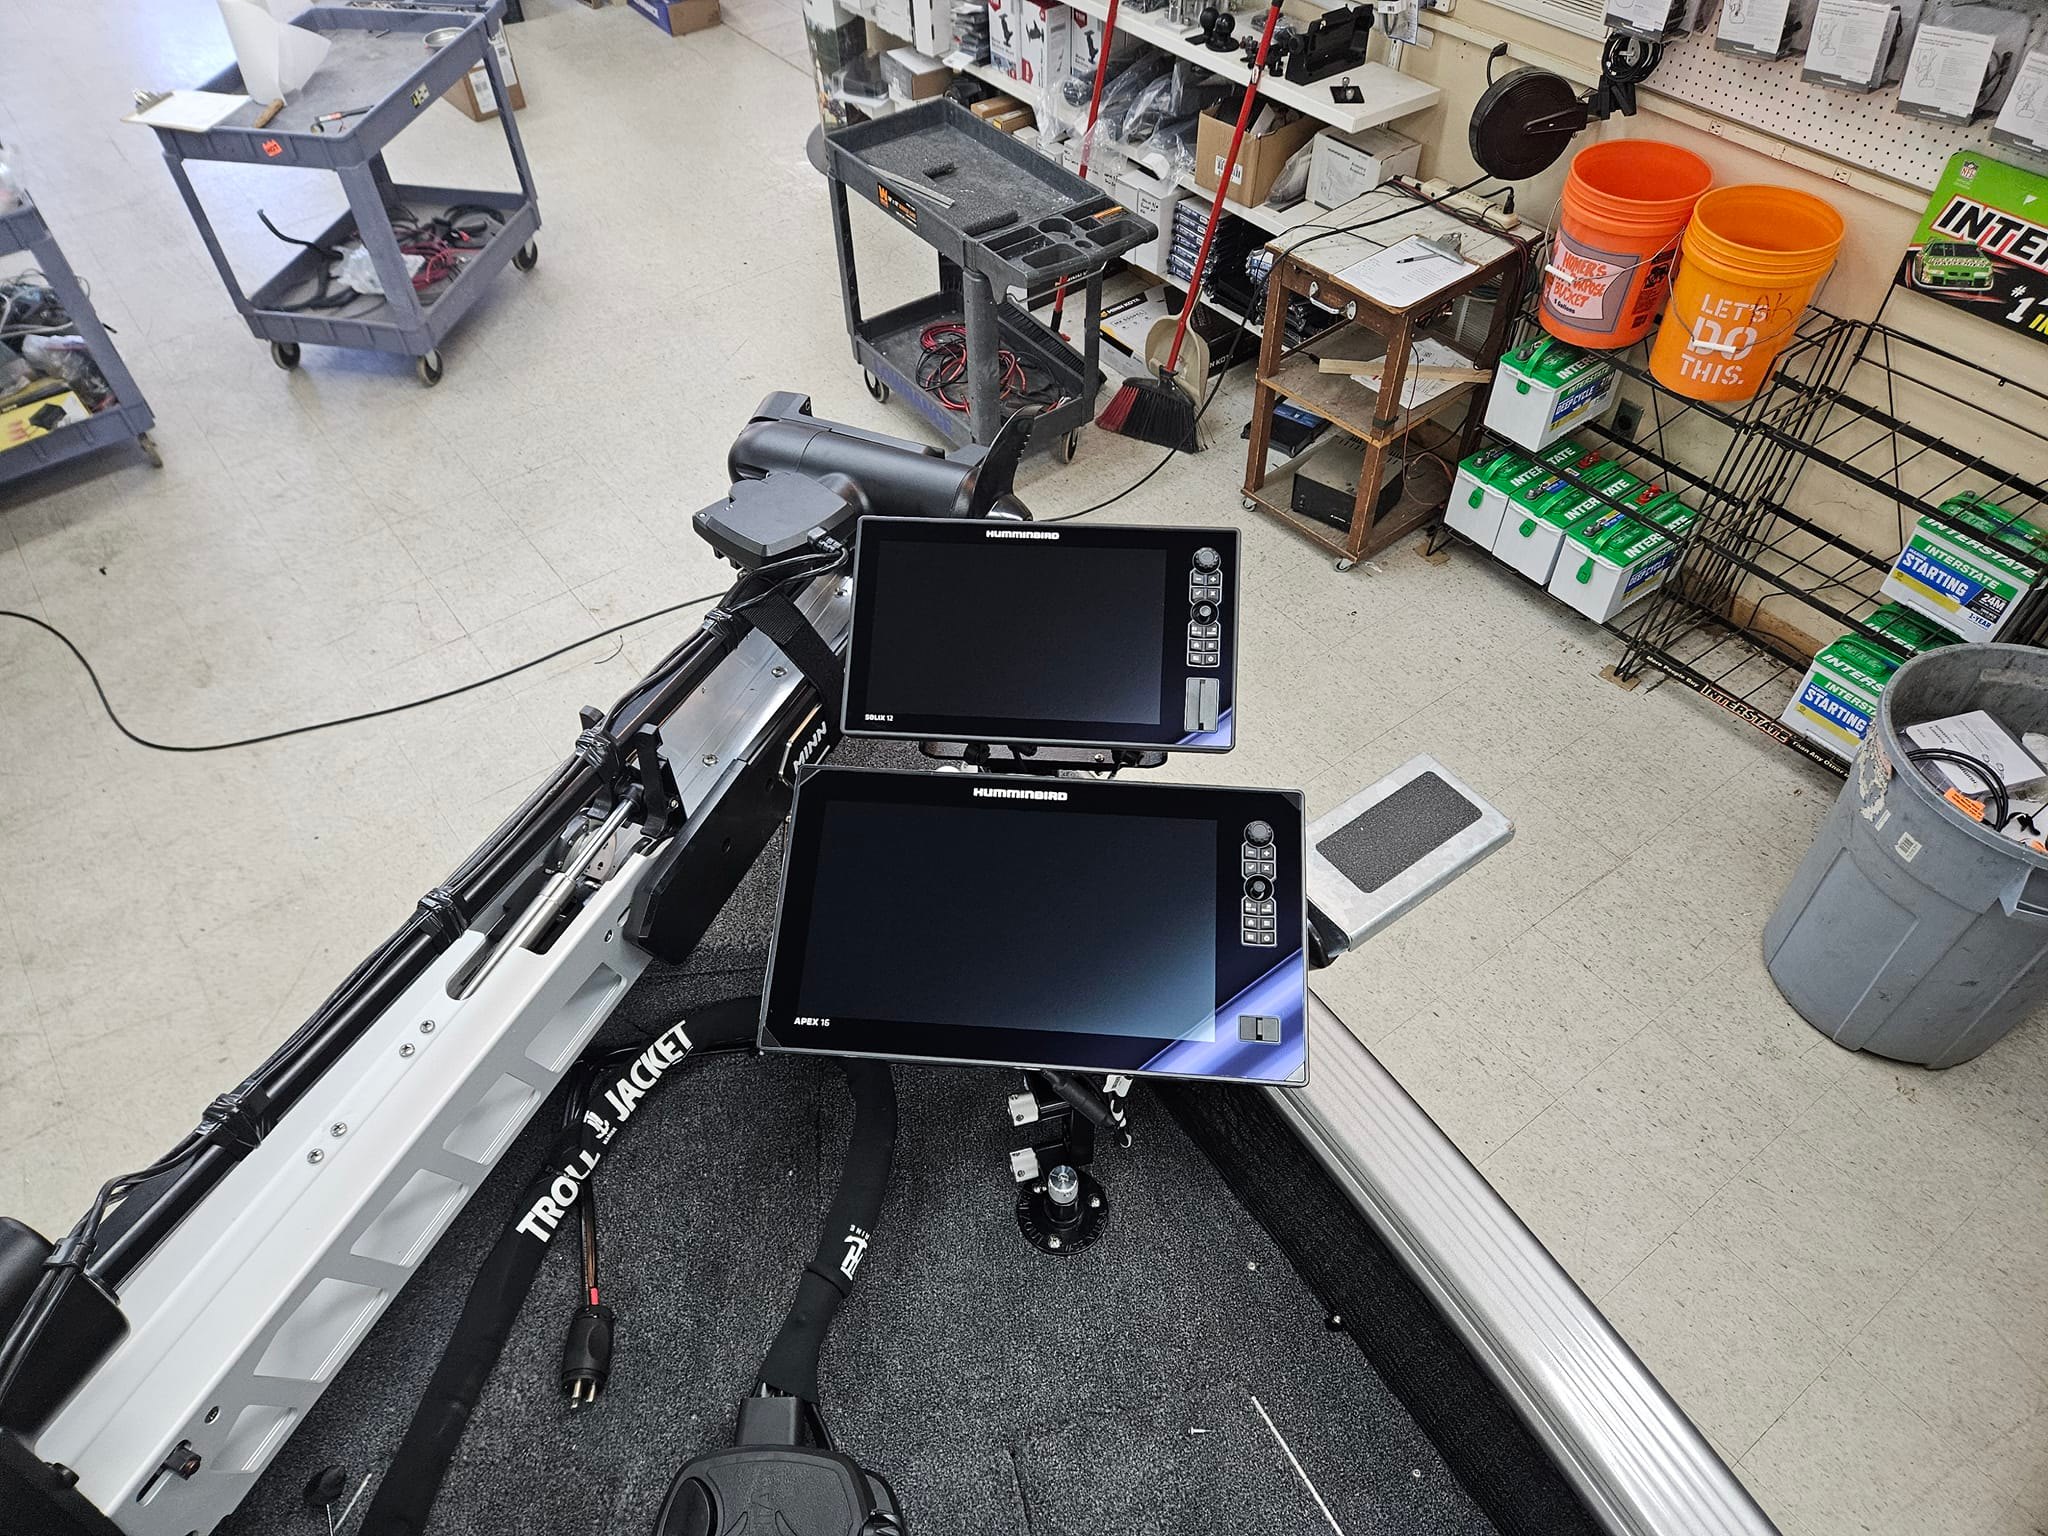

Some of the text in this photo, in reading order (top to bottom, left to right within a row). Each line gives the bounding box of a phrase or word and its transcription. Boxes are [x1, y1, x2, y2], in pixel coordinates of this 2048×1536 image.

[1937, 199, 2048, 270] INTE
[1562, 251, 1607, 278] HOMER'S
[1553, 281, 1590, 308] BUCKET
[1557, 301, 1576, 314] Gallons
[1701, 293, 1768, 322] LET'S
[1687, 316, 1757, 361] DO
[1680, 353, 1744, 385] THIS.
[985, 529, 1060, 540] HUMMINBIRD
[1924, 517, 2037, 579] INTERSTATE
[1902, 552, 1969, 597] STARTING
[1923, 544, 2000, 590] INTERSTATE
[1980, 592, 2007, 612] 24M
[864, 713, 894, 722] SOLIX 12
[1646, 655, 1663, 669] More
[1663, 664, 1685, 680] People
[1701, 683, 1791, 744] INTERSTATE
[1809, 750, 1824, 764] Any
[1804, 689, 1868, 732] STARTING
[793, 720, 827, 775] MINN
[973, 787, 1068, 801] HUMMINBIRD
[793, 1016, 831, 1027] APEX 16
[515, 1020, 693, 1243] TROLL JACKET
